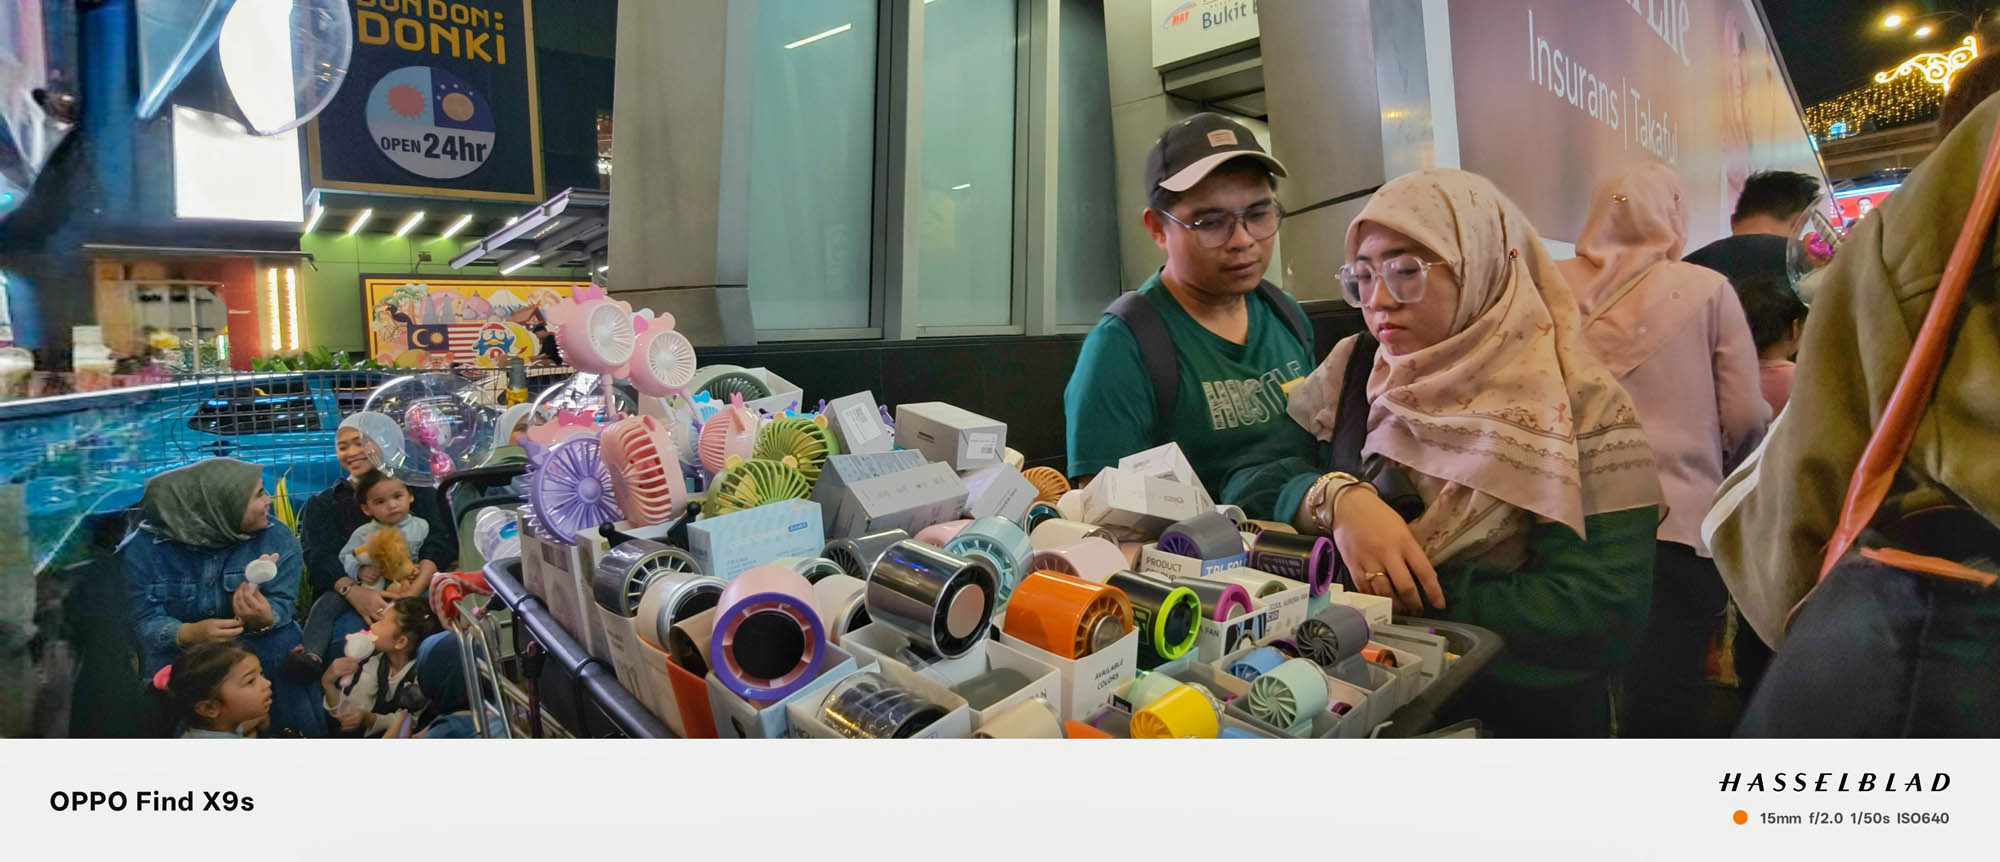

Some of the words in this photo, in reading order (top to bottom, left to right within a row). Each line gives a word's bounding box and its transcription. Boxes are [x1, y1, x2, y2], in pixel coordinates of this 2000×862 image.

[1202, 2, 1247, 29] Bukit
[1528, 9, 1619, 131] Insurans
[1630, 87, 1679, 166] Takaful
[380, 136, 421, 153] OPEN
[423, 133, 487, 162] 24hr
[1146, 556, 1182, 572] PRODUCT
[1095, 658, 1124, 680] AVAILABLE
